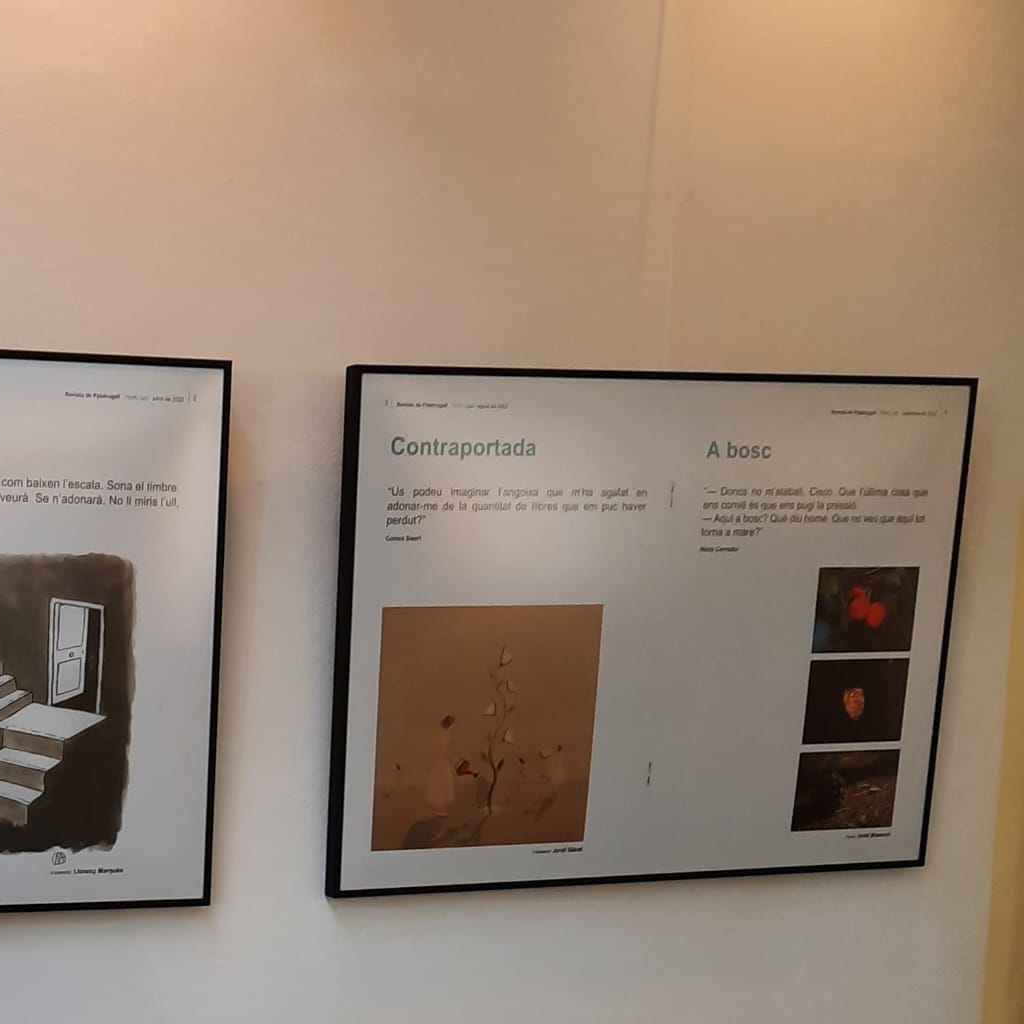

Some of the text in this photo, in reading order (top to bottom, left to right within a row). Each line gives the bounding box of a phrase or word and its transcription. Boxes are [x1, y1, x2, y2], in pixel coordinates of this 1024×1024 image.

[390, 436, 536, 460] Contraportada
[706, 440, 772, 459] A bosc
[1, 478, 23, 488] com
[26, 476, 60, 489] baixen
[62, 477, 104, 490] l'escala.
[106, 479, 133, 491] Sona
[135, 480, 144, 491] el
[35, 492, 49, 504] Se
[109, 494, 124, 506] No
[126, 495, 132, 506] li
[134, 495, 158, 507] miris
[412, 486, 443, 499] podeu
[450, 486, 490, 499] imaginar
[546, 488, 564, 499] que
[636, 489, 648, 497] en
[720, 486, 748, 496] Doncs
[751, 488, 762, 496] no
[838, 486, 856, 496] Que
[891, 488, 910, 496] cosa
[912, 488, 929, 499] que
[386, 500, 438, 511] adonar-me
[442, 500, 454, 511] de
[458, 500, 467, 511] la
[471, 500, 511, 514] quantitat
[515, 500, 527, 511] de
[562, 503, 579, 514] que
[583, 503, 598, 511] em
[601, 503, 618, 514] puc
[621, 501, 647, 511] haver
[702, 502, 719, 510] ens
[721, 500, 746, 510] convé
[748, 500, 759, 510] és
[760, 502, 778, 512] que
[779, 502, 795, 510] ens
[796, 500, 815, 512] pugi
[816, 500, 825, 510] la
[700, 527, 724, 536] torna
